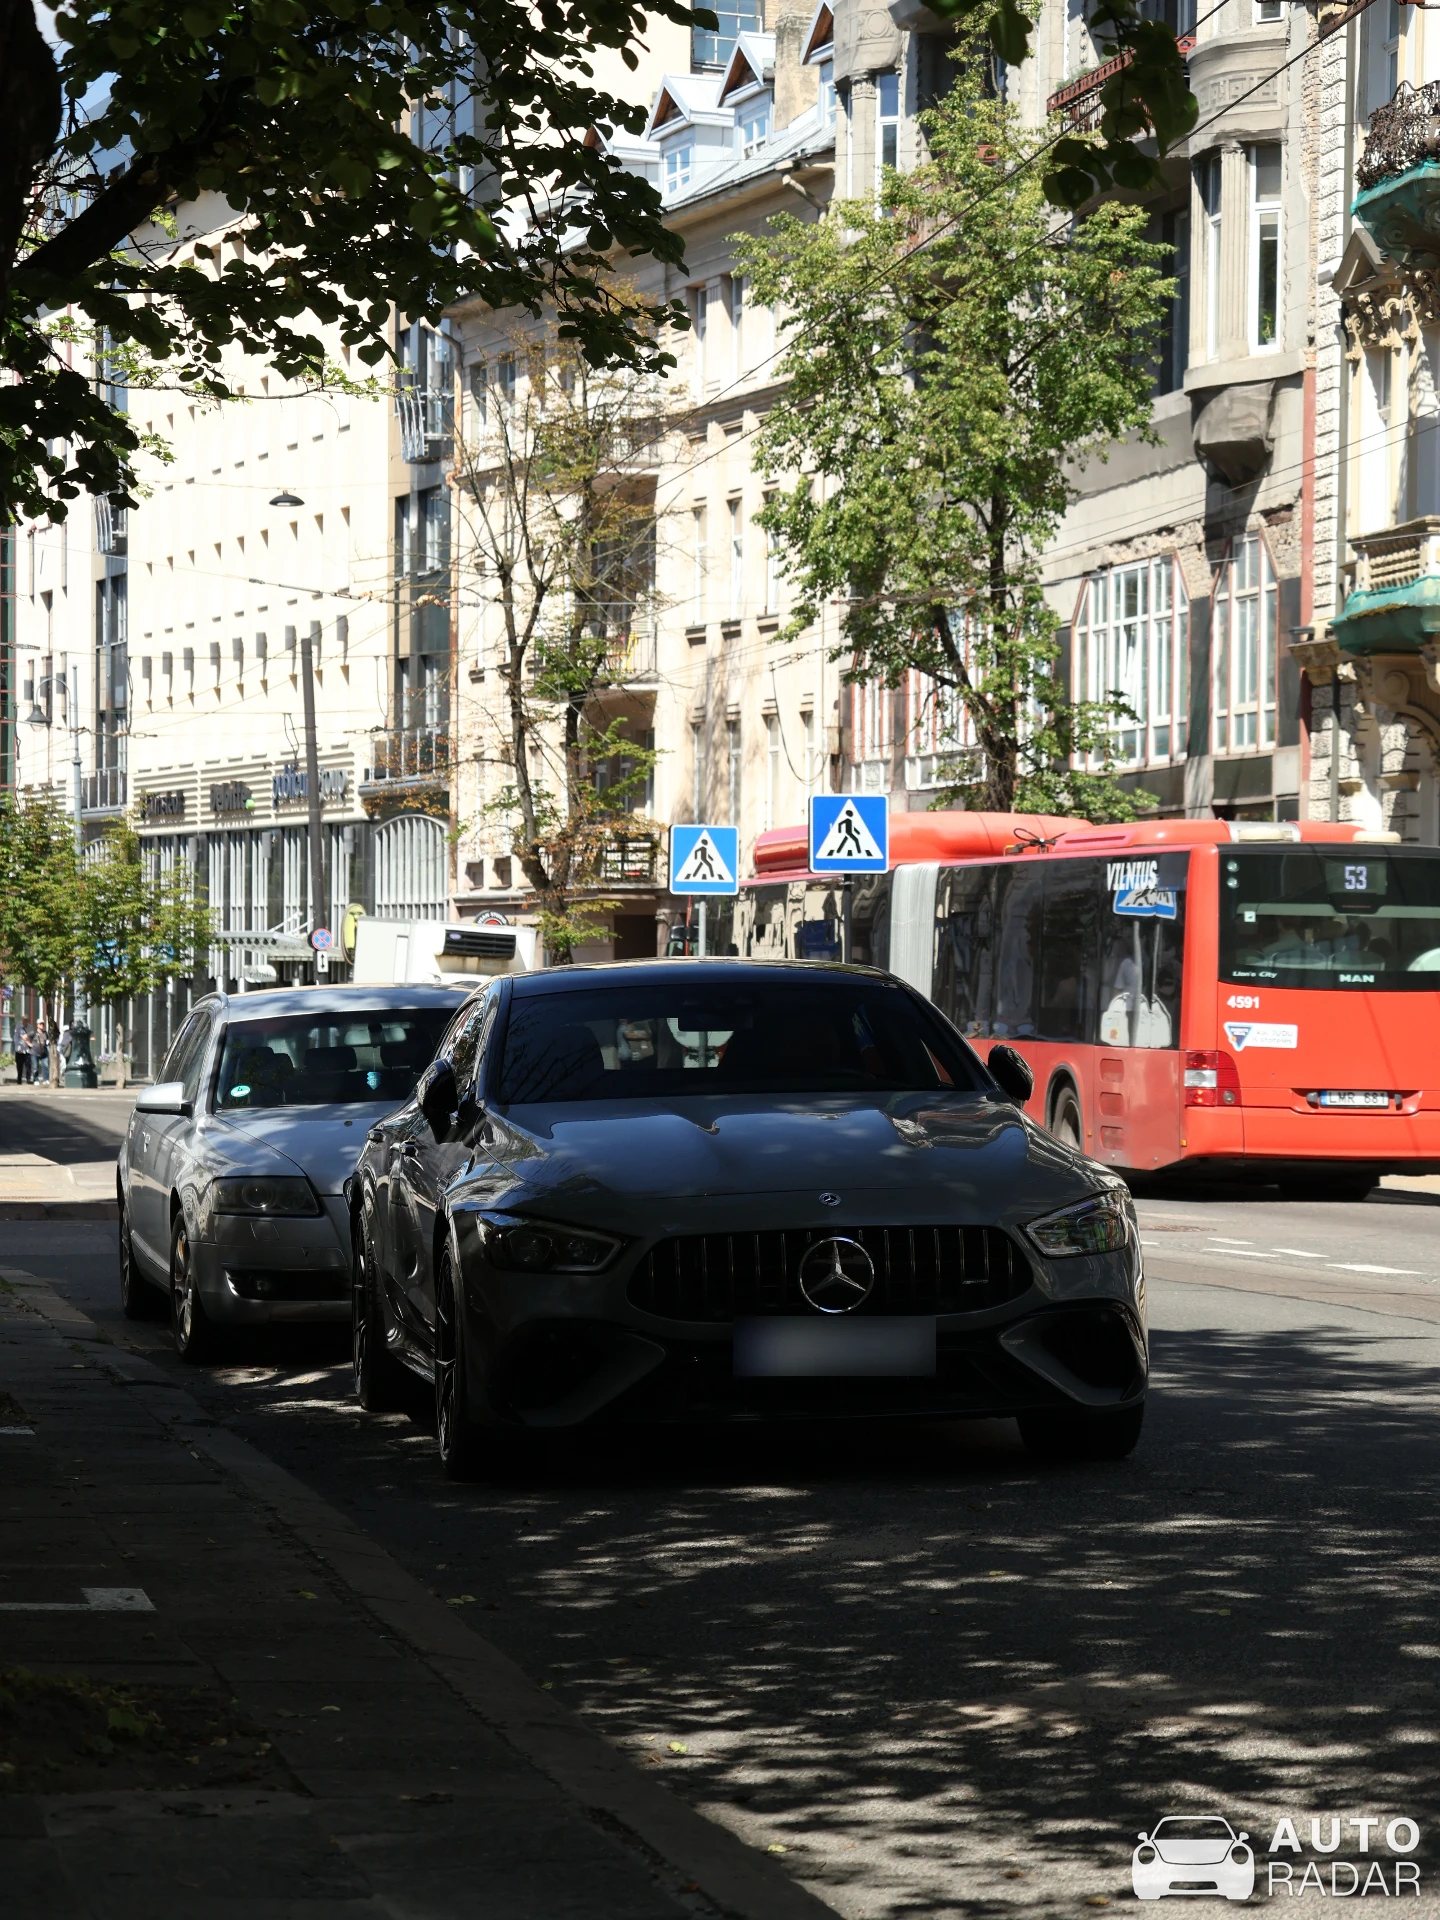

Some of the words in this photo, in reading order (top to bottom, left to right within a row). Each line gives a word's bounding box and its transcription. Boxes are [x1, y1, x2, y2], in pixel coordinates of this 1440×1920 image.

[1106, 860, 1158, 892] VILNIUS
[1344, 866, 1367, 890] 53
[1259, 971, 1278, 979] City
[1339, 974, 1375, 983] MAN
[1226, 995, 1260, 1009] 4591
[1329, 1092, 1355, 1104] LMR
